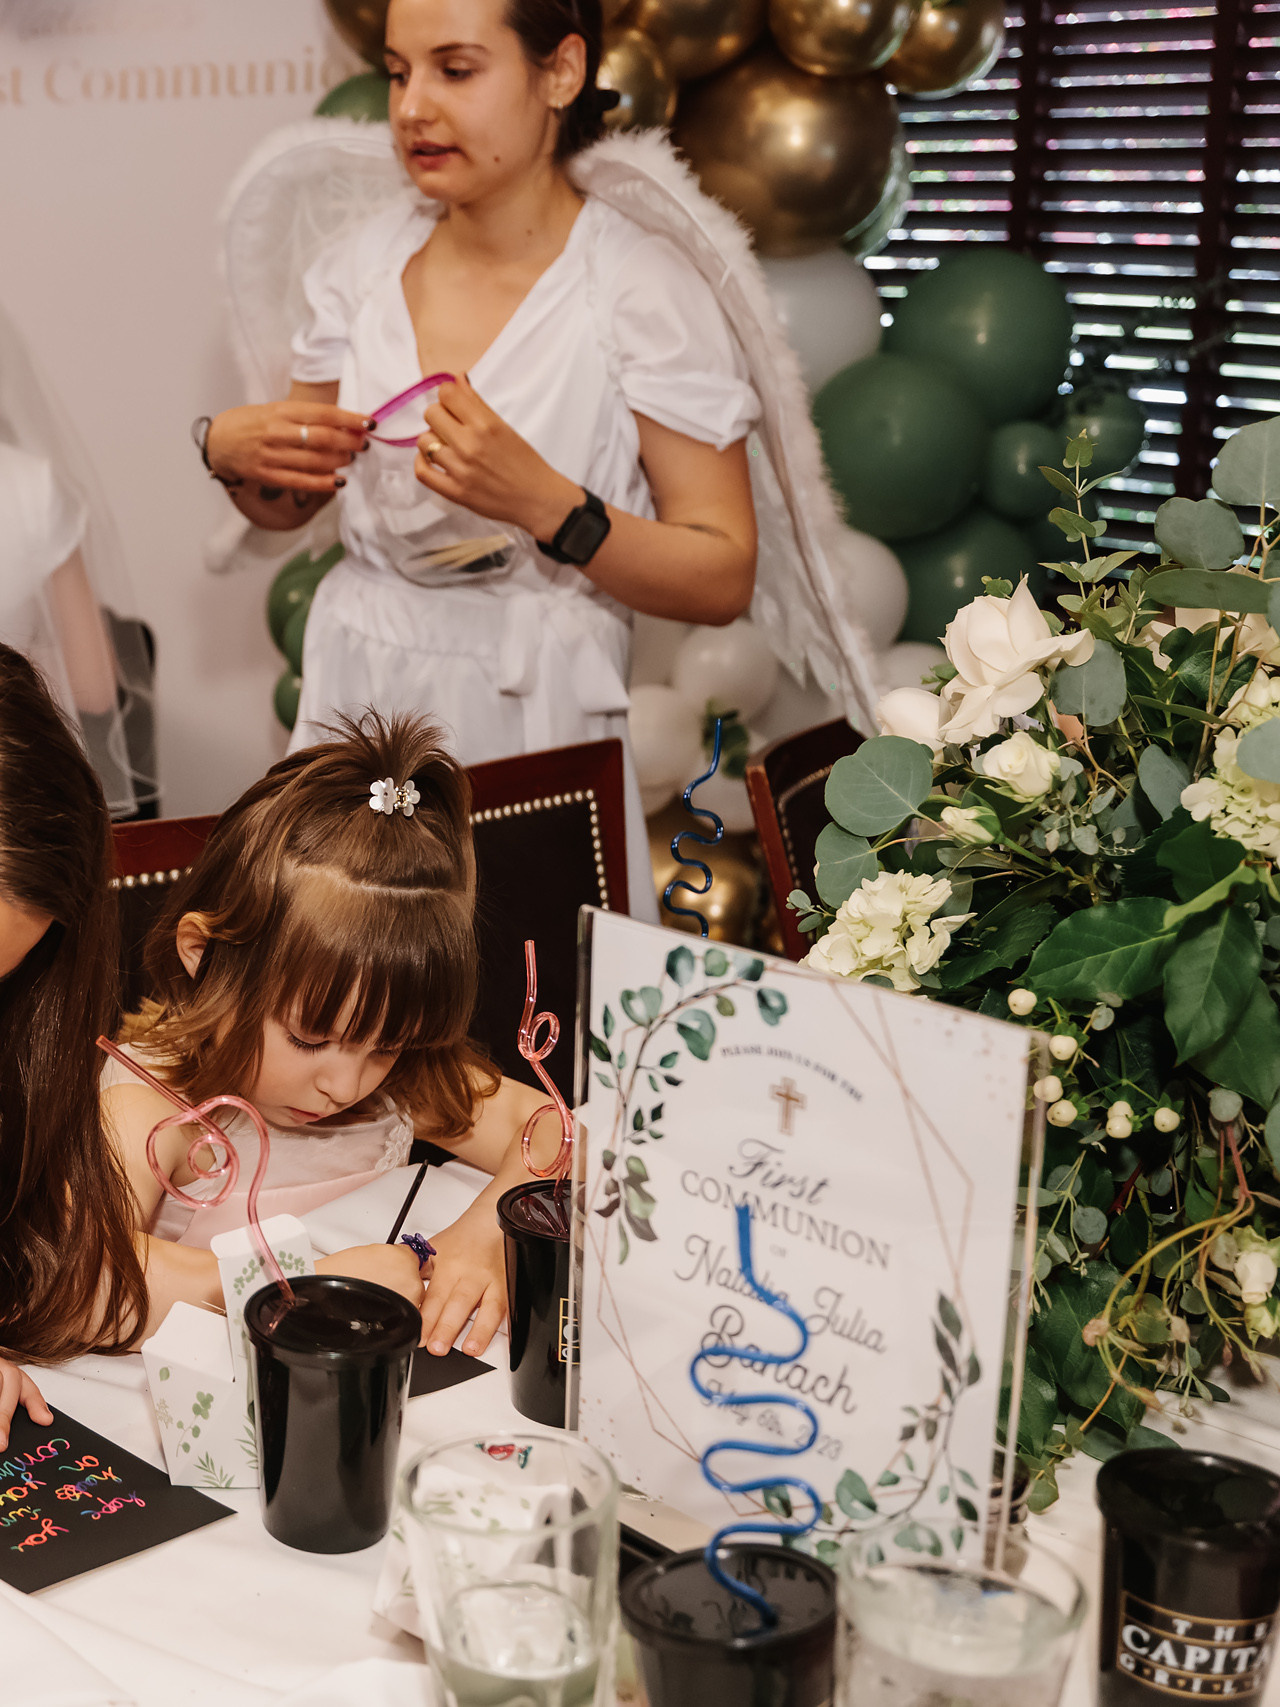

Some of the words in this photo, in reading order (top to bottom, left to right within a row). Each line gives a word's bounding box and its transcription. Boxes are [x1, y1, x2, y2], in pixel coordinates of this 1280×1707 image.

[42, 45, 354, 104] Communio
[729, 1138, 830, 1205] First
[680, 1169, 891, 1270] COMMUNION
[803, 1286, 888, 1354] Julia
[58, 1454, 100, 1472] on
[794, 1424, 843, 1460] 223
[80, 1490, 146, 1520] hope
[10, 1518, 70, 1553] you
